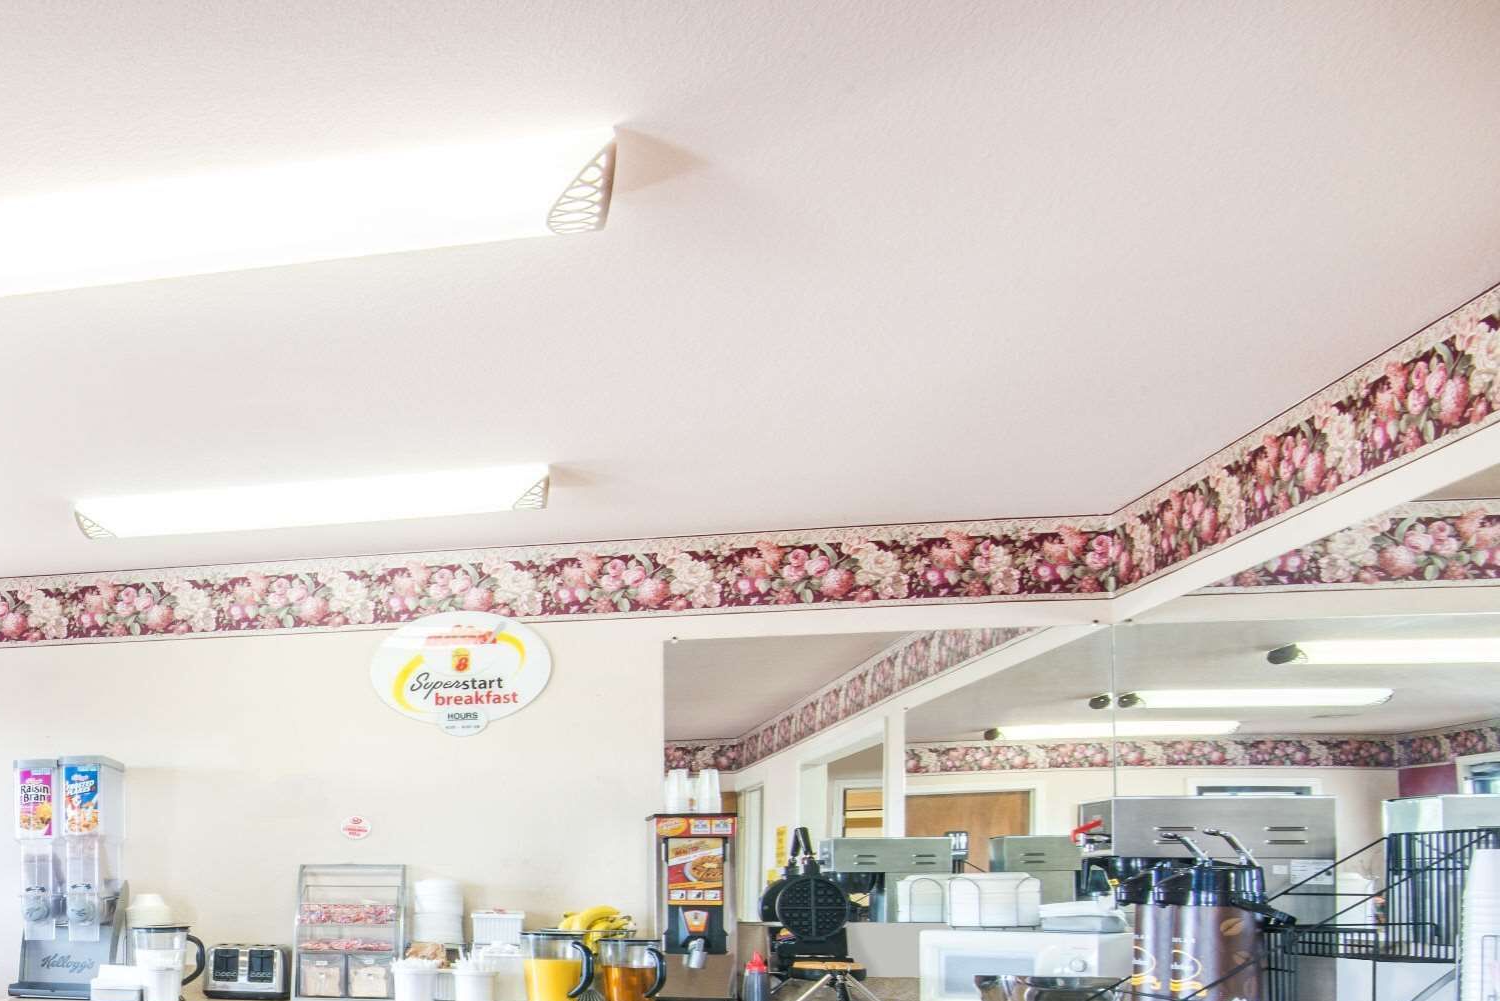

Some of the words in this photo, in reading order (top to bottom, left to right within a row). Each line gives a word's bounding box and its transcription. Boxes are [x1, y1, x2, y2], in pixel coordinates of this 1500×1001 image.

[434, 690, 518, 706] breakfast
[447, 711, 479, 720] HOURS
[20, 784, 49, 795] Raisin
[23, 793, 46, 803] Bran
[40, 953, 95, 974] Kellogg's
